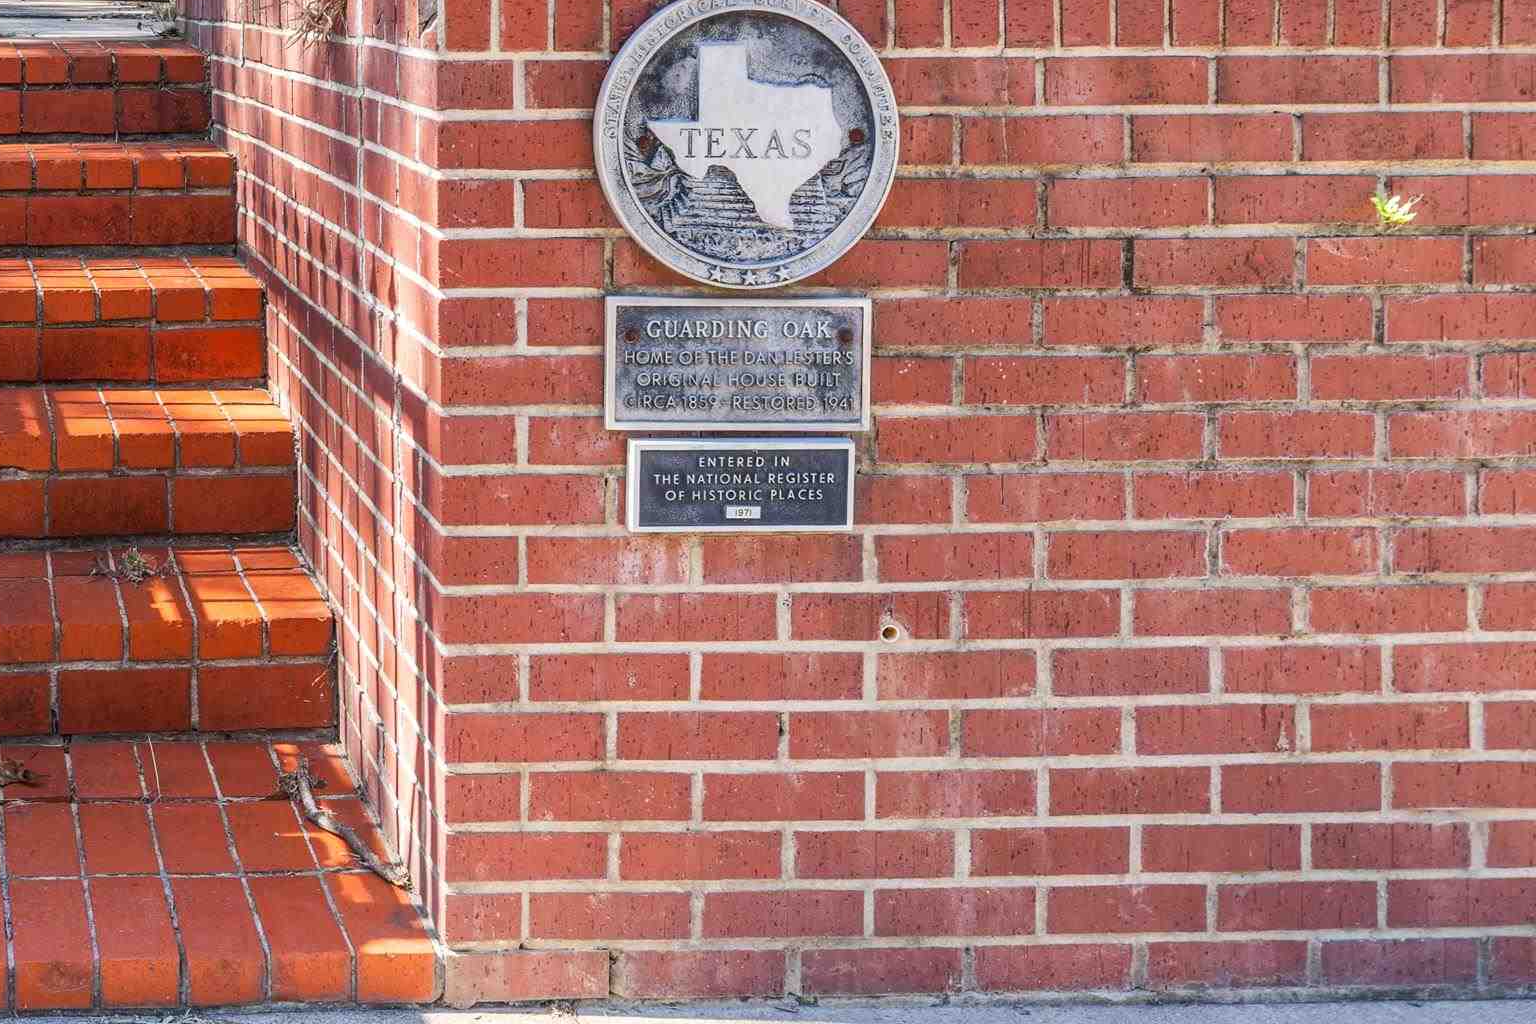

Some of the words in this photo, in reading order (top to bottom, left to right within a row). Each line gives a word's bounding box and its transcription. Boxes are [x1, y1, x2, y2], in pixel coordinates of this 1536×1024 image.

[679, 128, 812, 160] TEXAS
[646, 319, 769, 338] GUARDING
[783, 320, 832, 338] OAK
[624, 350, 673, 365] HOME
[678, 350, 701, 365] OF
[707, 350, 737, 365] THE
[744, 350, 778, 365] DAN
[784, 350, 855, 366] LESTER'S
[636, 372, 721, 387] ORIGINAL
[728, 372, 785, 387] HOUSE
[795, 372, 842, 387] BUILT
[624, 394, 675, 409] CIRCA
[732, 394, 816, 410] RESTORED
[699, 456, 764, 468] ENTERED
[775, 456, 791, 467] IN
[654, 474, 680, 485] THE
[687, 474, 761, 485] NATIONAL
[768, 473, 835, 484] REGISTER
[665, 490, 685, 501] OF
[692, 490, 763, 501] HISTORIC
[771, 489, 824, 501] PLACES
